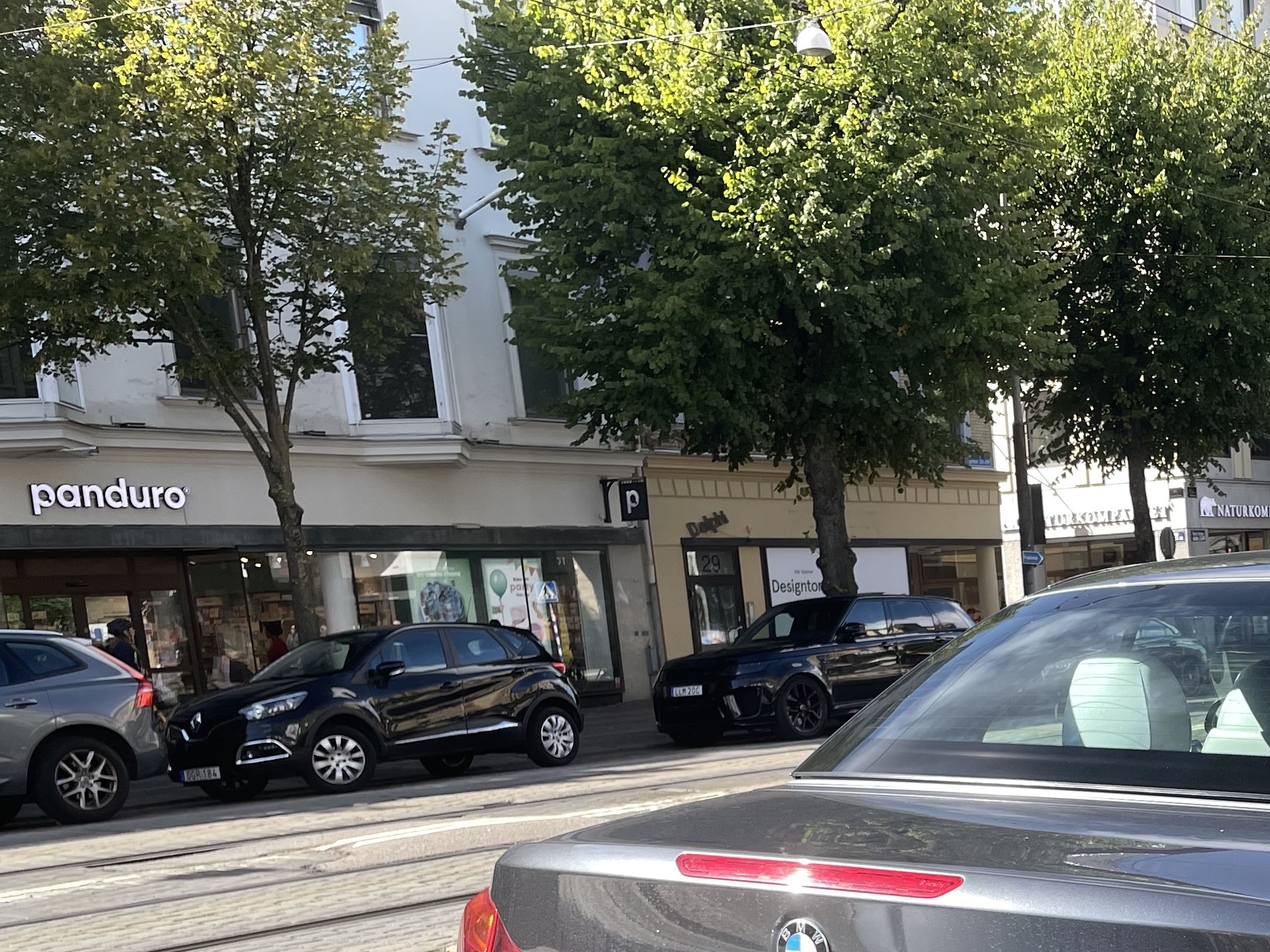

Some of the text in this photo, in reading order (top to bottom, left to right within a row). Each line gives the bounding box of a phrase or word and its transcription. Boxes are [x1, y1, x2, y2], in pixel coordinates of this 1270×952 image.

[625, 489, 640, 514] p
[702, 555, 720, 573] 29
[781, 921, 824, 945] BMW
